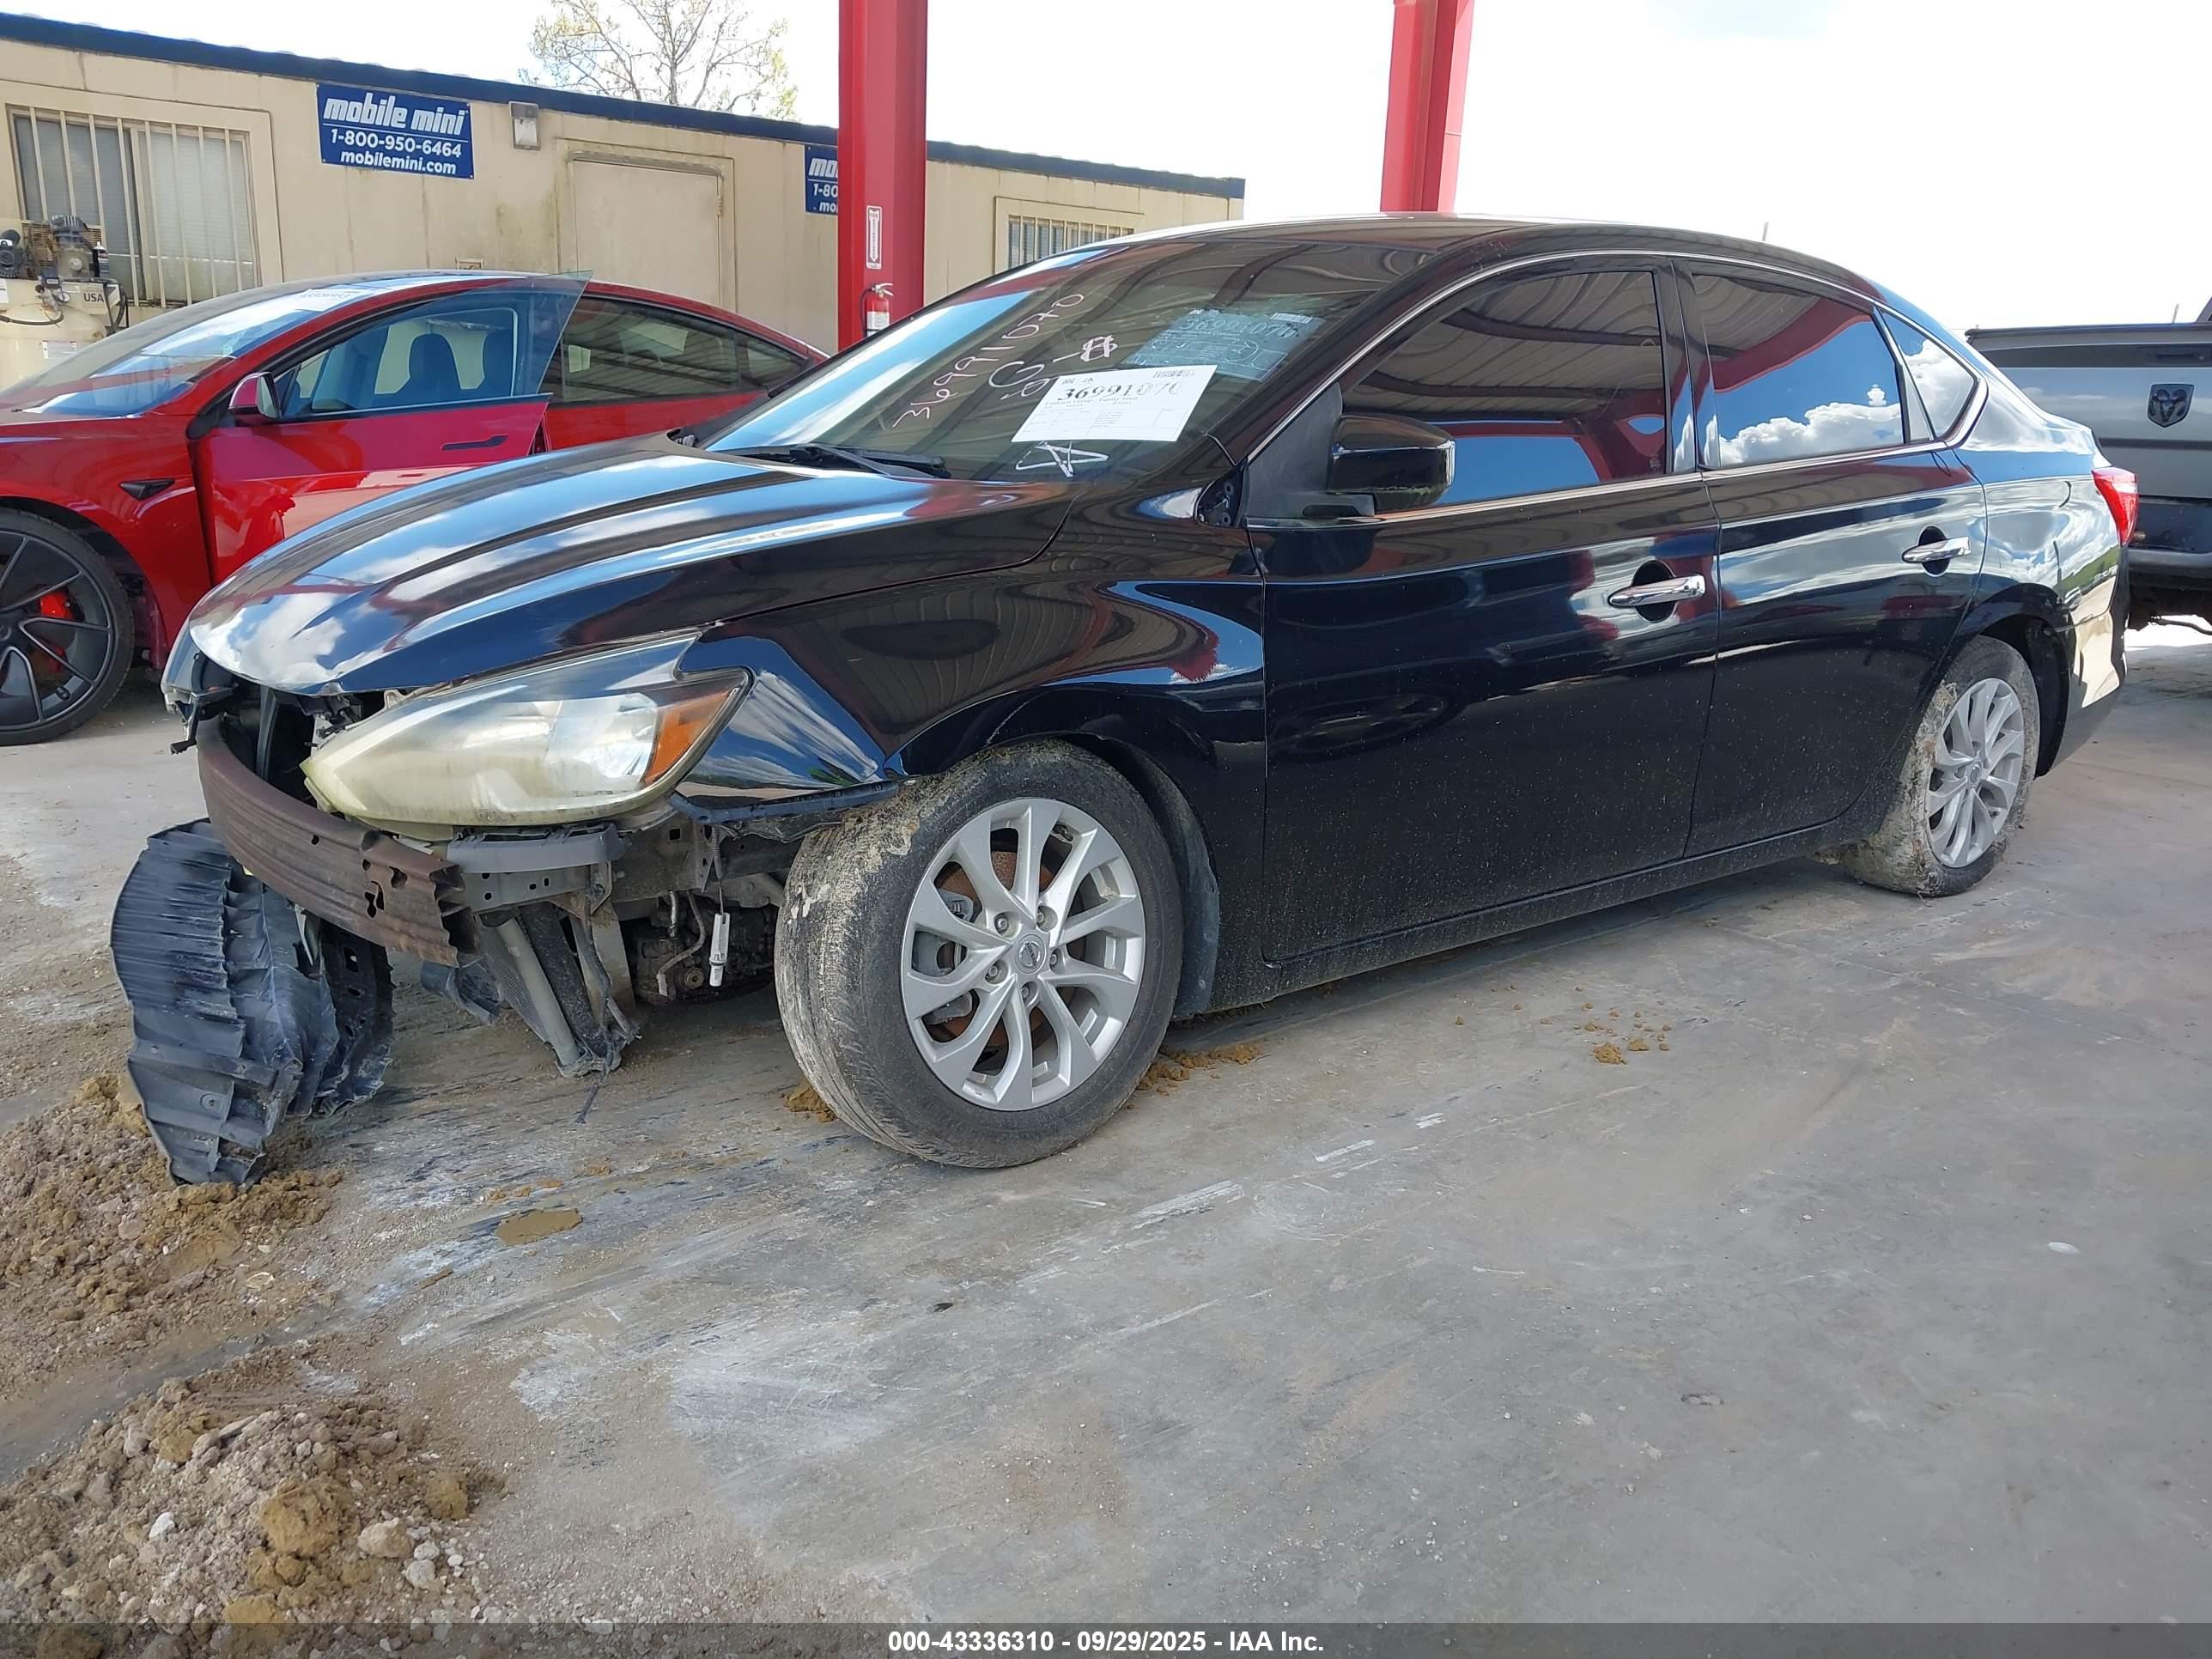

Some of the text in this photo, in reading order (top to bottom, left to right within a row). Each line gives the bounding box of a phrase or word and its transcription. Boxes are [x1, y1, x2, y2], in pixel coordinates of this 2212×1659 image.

[323, 92, 465, 136] mobile mini
[331, 128, 462, 158] 1-800-950-6464
[340, 150, 457, 174] mobilemini.com
[83, 293, 104, 302] USA
